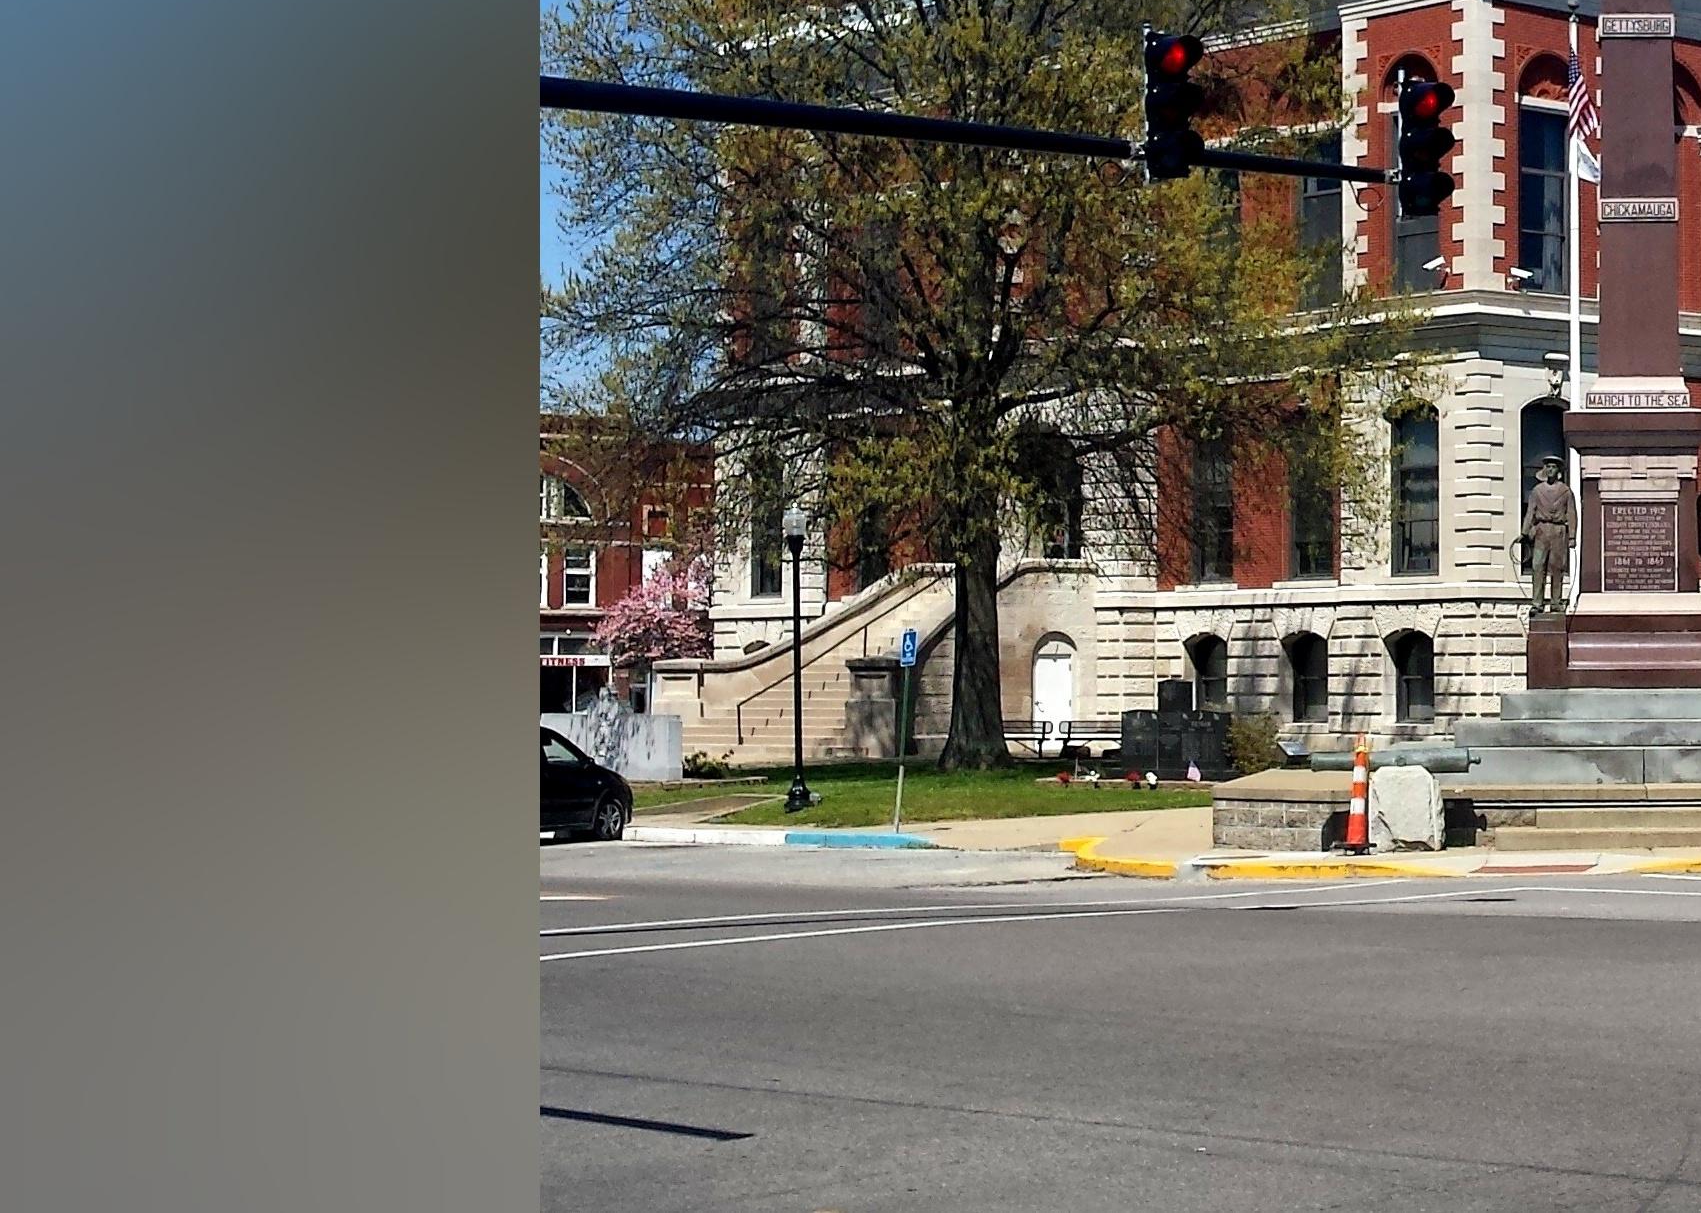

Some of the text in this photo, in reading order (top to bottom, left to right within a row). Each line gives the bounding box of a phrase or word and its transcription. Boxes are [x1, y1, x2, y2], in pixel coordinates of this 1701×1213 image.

[1605, 19, 1669, 32] GETTYSBURG
[1604, 204, 1673, 216] CHICKAMAUGA
[1588, 395, 1688, 406] MARCH TO THE SEA
[1612, 506, 1647, 515] ERECTED
[1614, 557, 1631, 566] 1861
